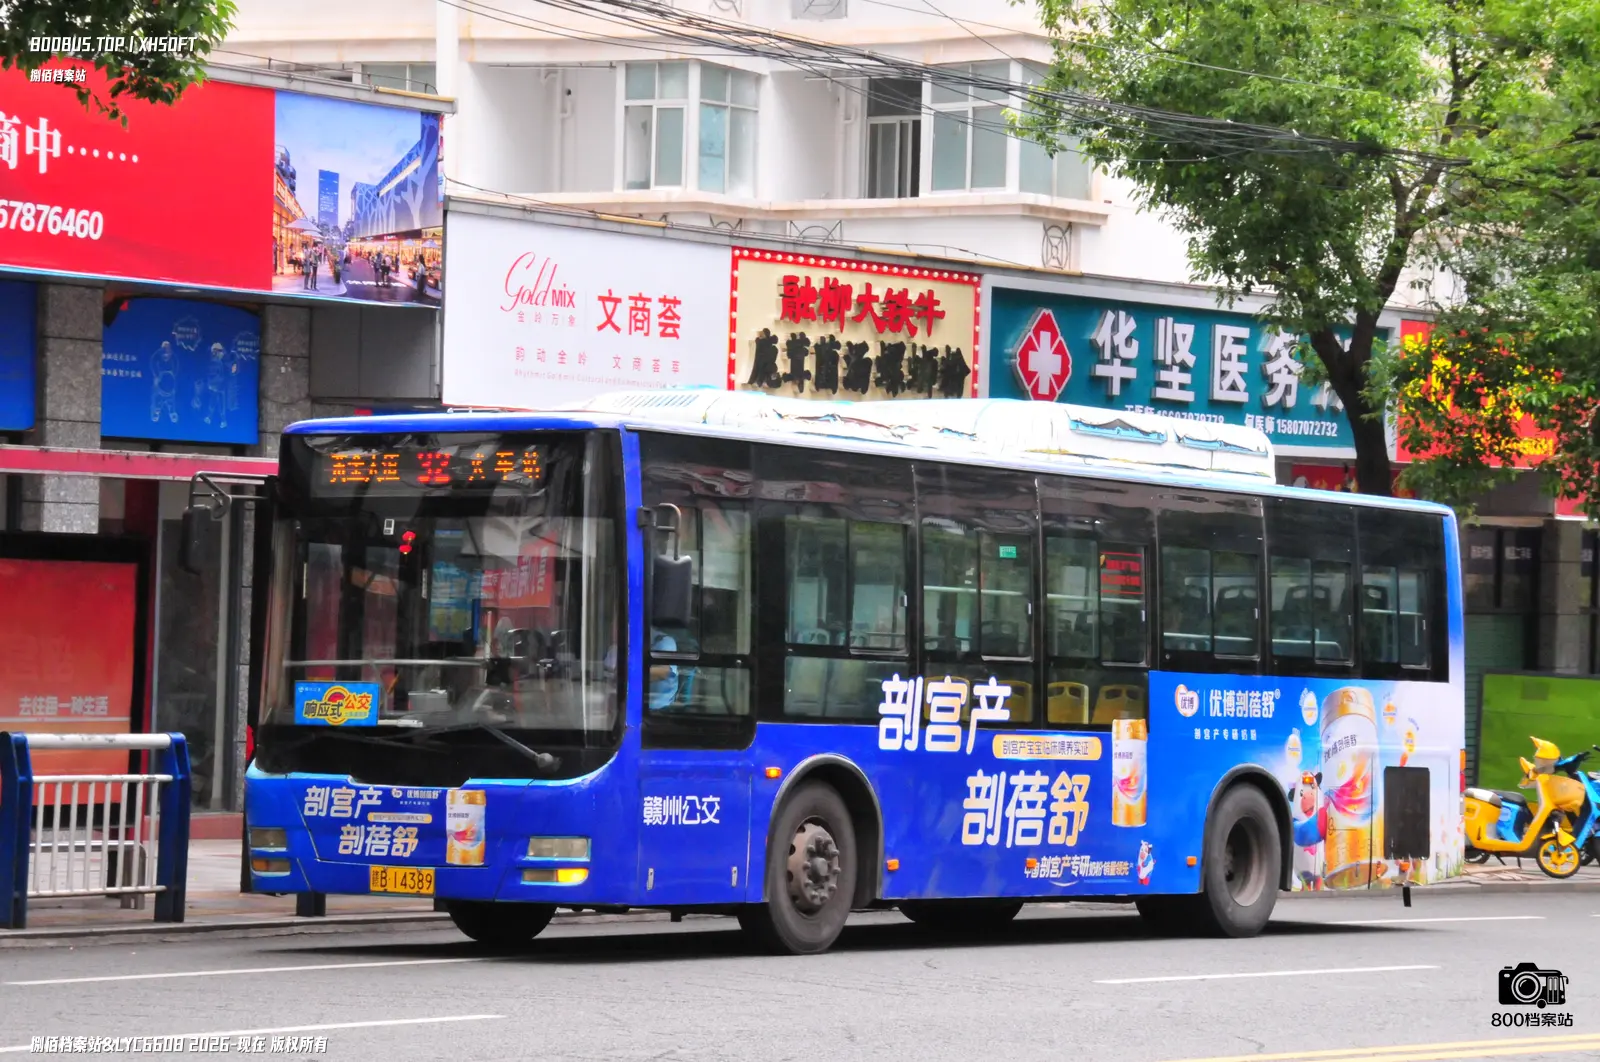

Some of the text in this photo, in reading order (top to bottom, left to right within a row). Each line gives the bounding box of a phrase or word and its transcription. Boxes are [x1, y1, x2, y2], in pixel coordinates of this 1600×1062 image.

[500, 251, 558, 312] Gold
[596, 289, 682, 340] 文商荟
[780, 274, 946, 338] 融柳大铁牛
[1277, 418, 1338, 437] 15807072732
[304, 693, 372, 718] 响应式 公交
[878, 673, 1012, 755] 剖宫产
[303, 785, 383, 819] 剖宫产
[643, 795, 721, 826] 赣州公交
[961, 768, 1091, 848] 剖蓓舒
[338, 824, 419, 859] 剖蓓舒
